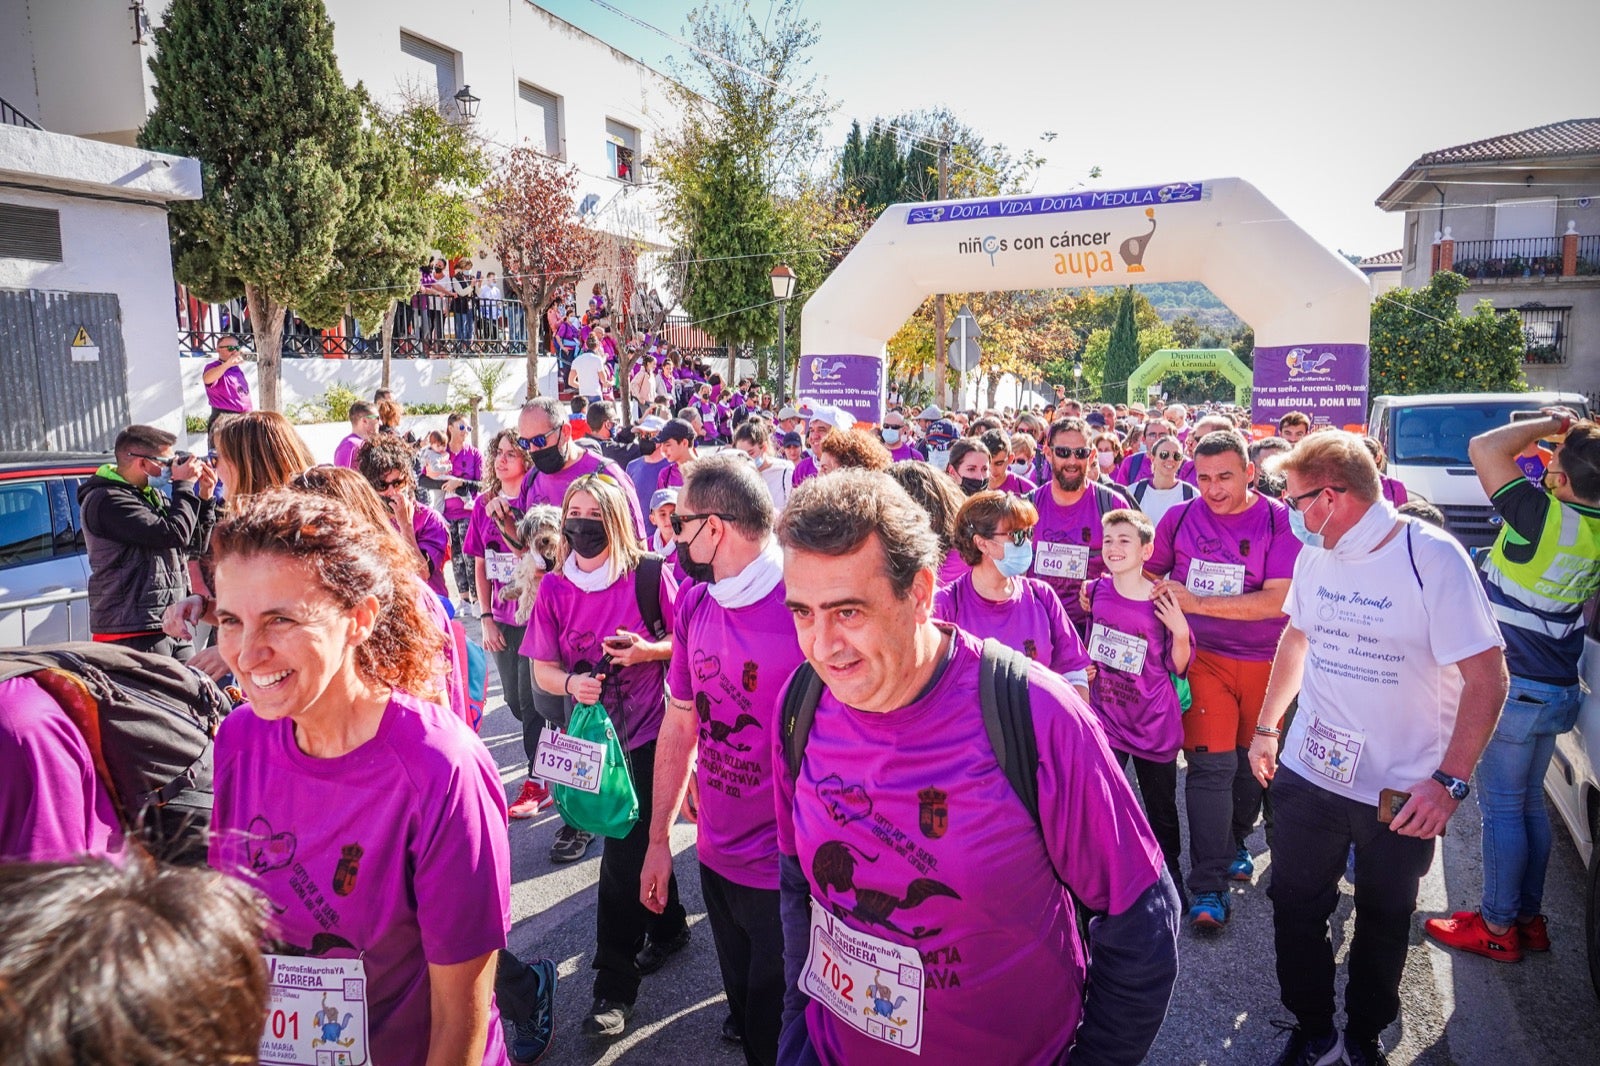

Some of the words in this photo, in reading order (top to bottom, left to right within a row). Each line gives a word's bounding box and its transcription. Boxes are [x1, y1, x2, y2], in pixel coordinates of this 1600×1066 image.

[1000, 200, 1033, 214] VIDA
[1013, 236, 1044, 250] con
[1050, 230, 1111, 248] cáncer
[1054, 249, 1114, 278] aupa
[1171, 352, 1217, 360] Diputación
[1182, 360, 1216, 368] Granada
[832, 399, 854, 408] DONA
[855, 399, 871, 408] VIDA
[1257, 398, 1276, 407] DONA
[1277, 395, 1317, 408] MÉDULA,
[1320, 398, 1345, 407] DONA
[1346, 398, 1361, 407] VIDA
[1043, 558, 1063, 570] 640
[1193, 577, 1215, 591] 642
[1357, 634, 1379, 645] peso
[1097, 643, 1117, 660] 628
[1322, 642, 1340, 652] con
[551, 732, 559, 744] V
[557, 740, 582, 752] CARRERA
[1305, 736, 1326, 760] 1283
[540, 752, 572, 772] 1379
[824, 910, 835, 937] V
[835, 932, 877, 964] CARRERA
[277, 973, 323, 987] CARRERA
[822, 951, 854, 1003] 702
[271, 1041, 295, 1052] MARÍA
